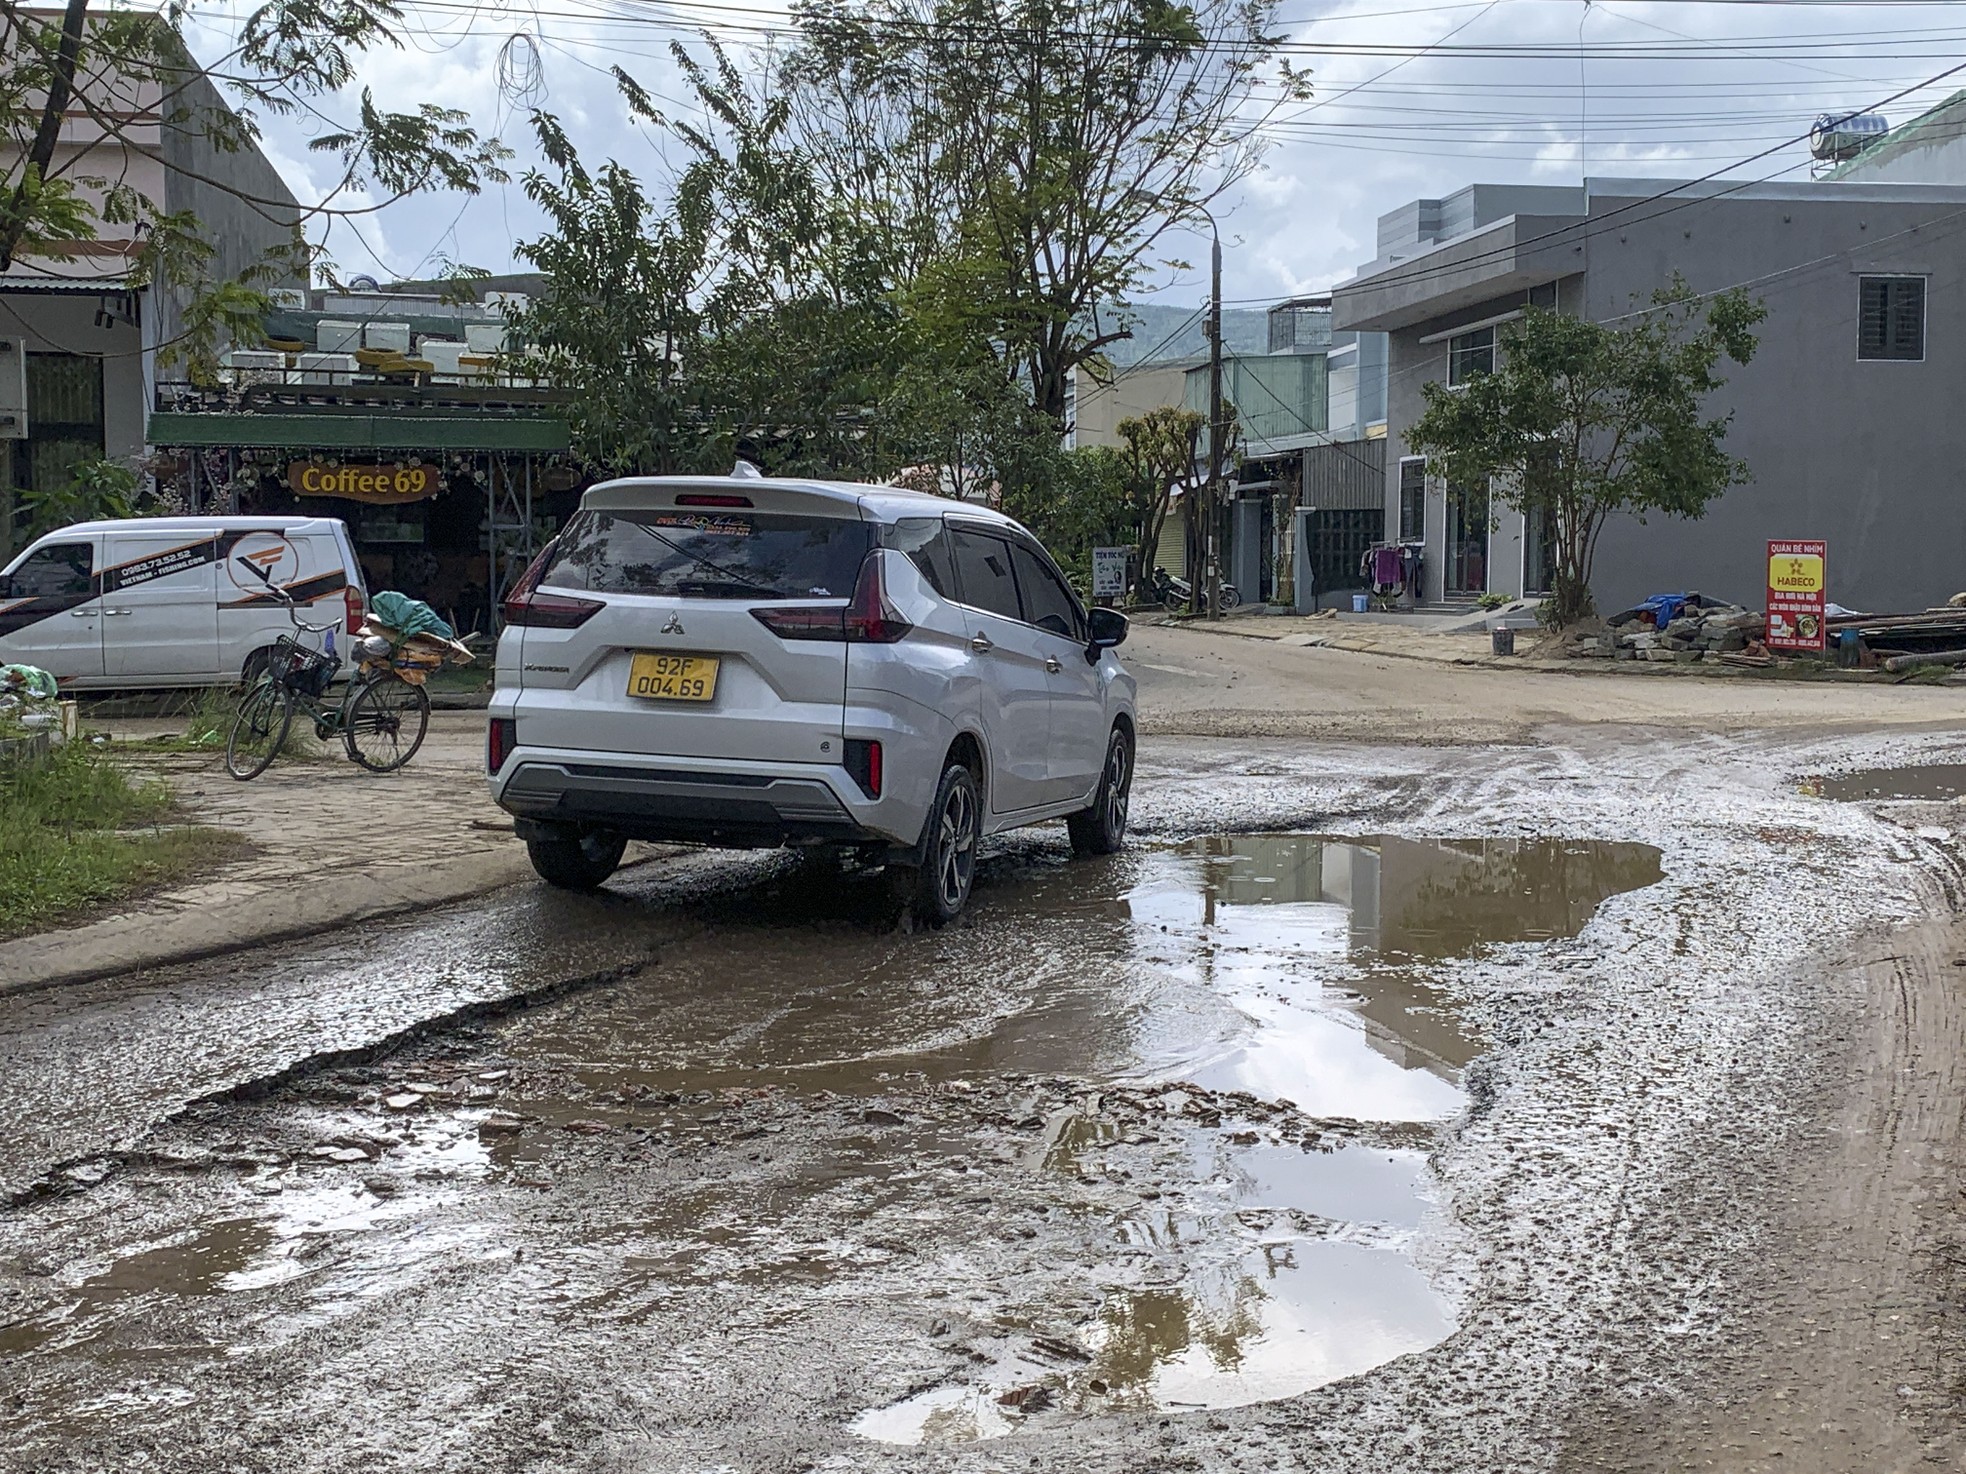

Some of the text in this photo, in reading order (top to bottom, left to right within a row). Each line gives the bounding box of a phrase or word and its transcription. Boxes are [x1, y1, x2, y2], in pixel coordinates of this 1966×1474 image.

[302, 468, 427, 493] Coffee 69
[120, 571, 153, 586] VIETNAM
[1777, 576, 1815, 587] HABECO
[656, 657, 694, 676] 92F
[637, 676, 704, 697] 004.69
